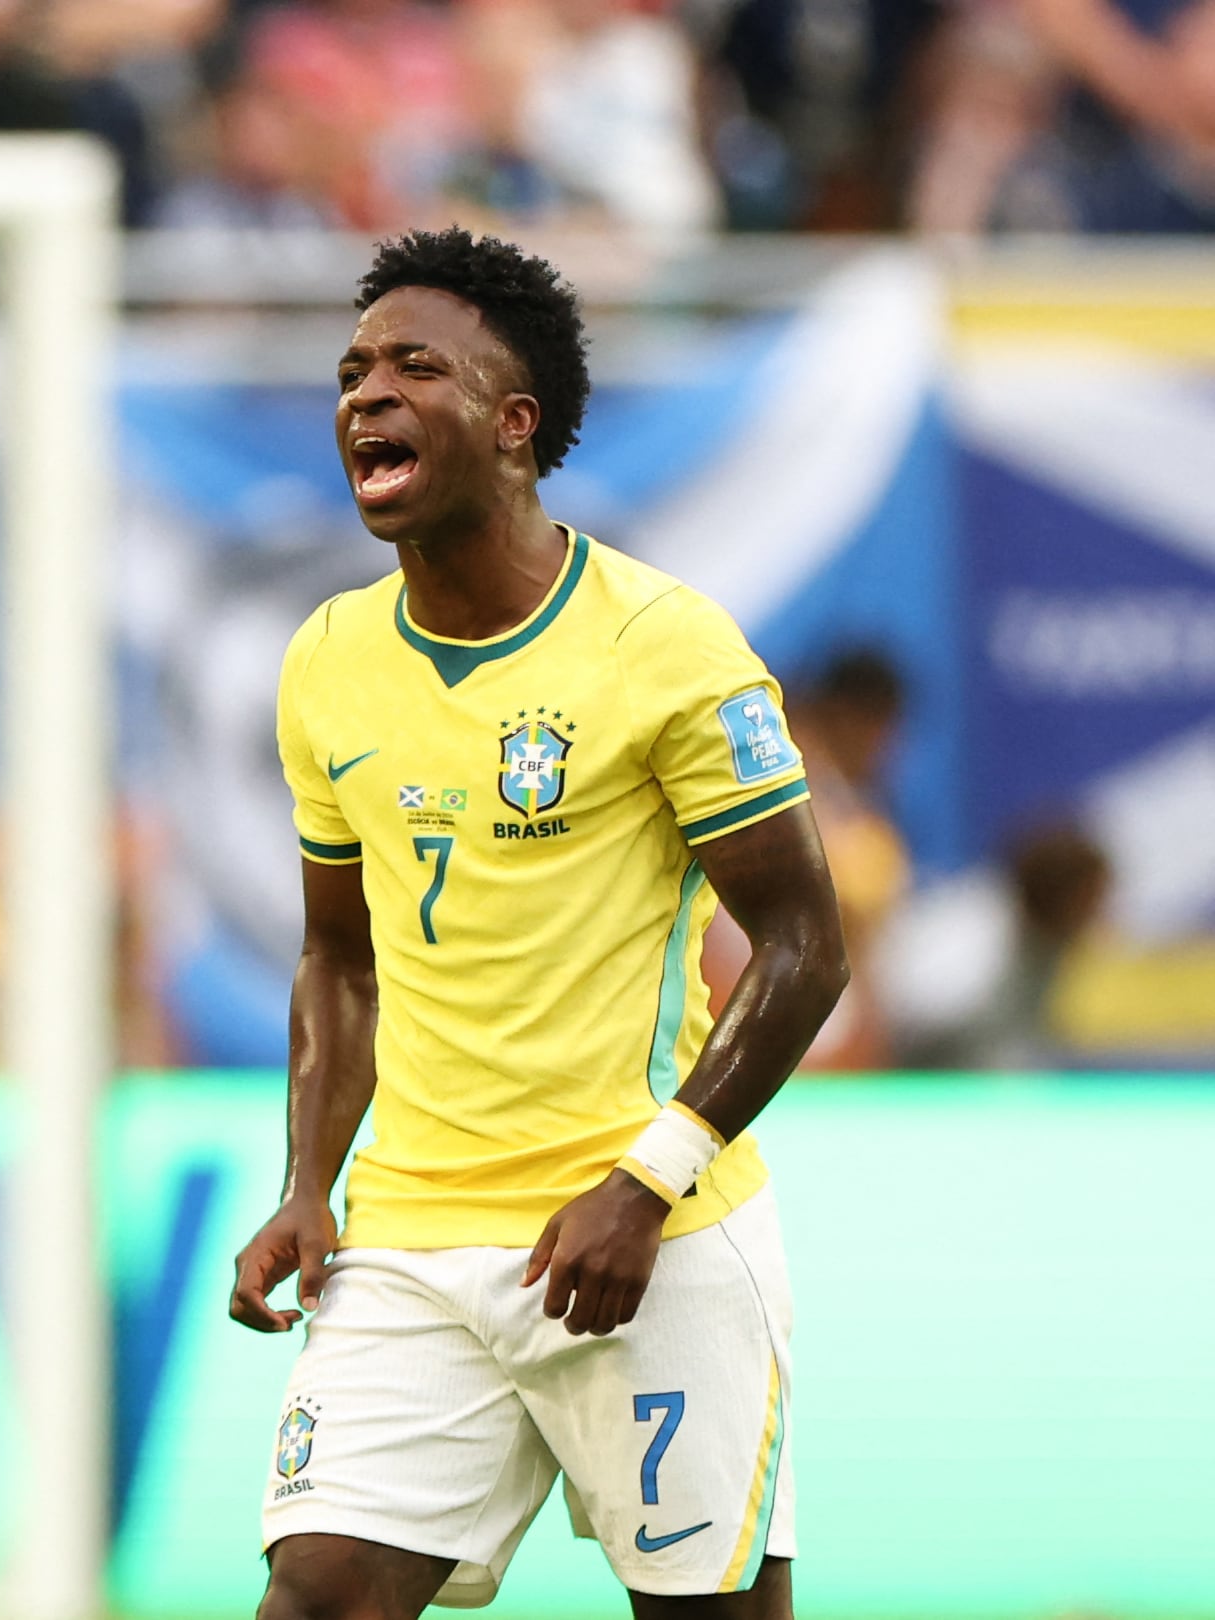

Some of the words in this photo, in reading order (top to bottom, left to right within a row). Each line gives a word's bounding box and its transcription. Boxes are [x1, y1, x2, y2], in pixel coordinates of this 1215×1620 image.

[518, 760, 546, 773] CBF
[493, 819, 571, 840] BRASIL
[411, 836, 455, 945] 7
[633, 1391, 685, 1505] 7
[274, 1478, 315, 1501] BRASIL
